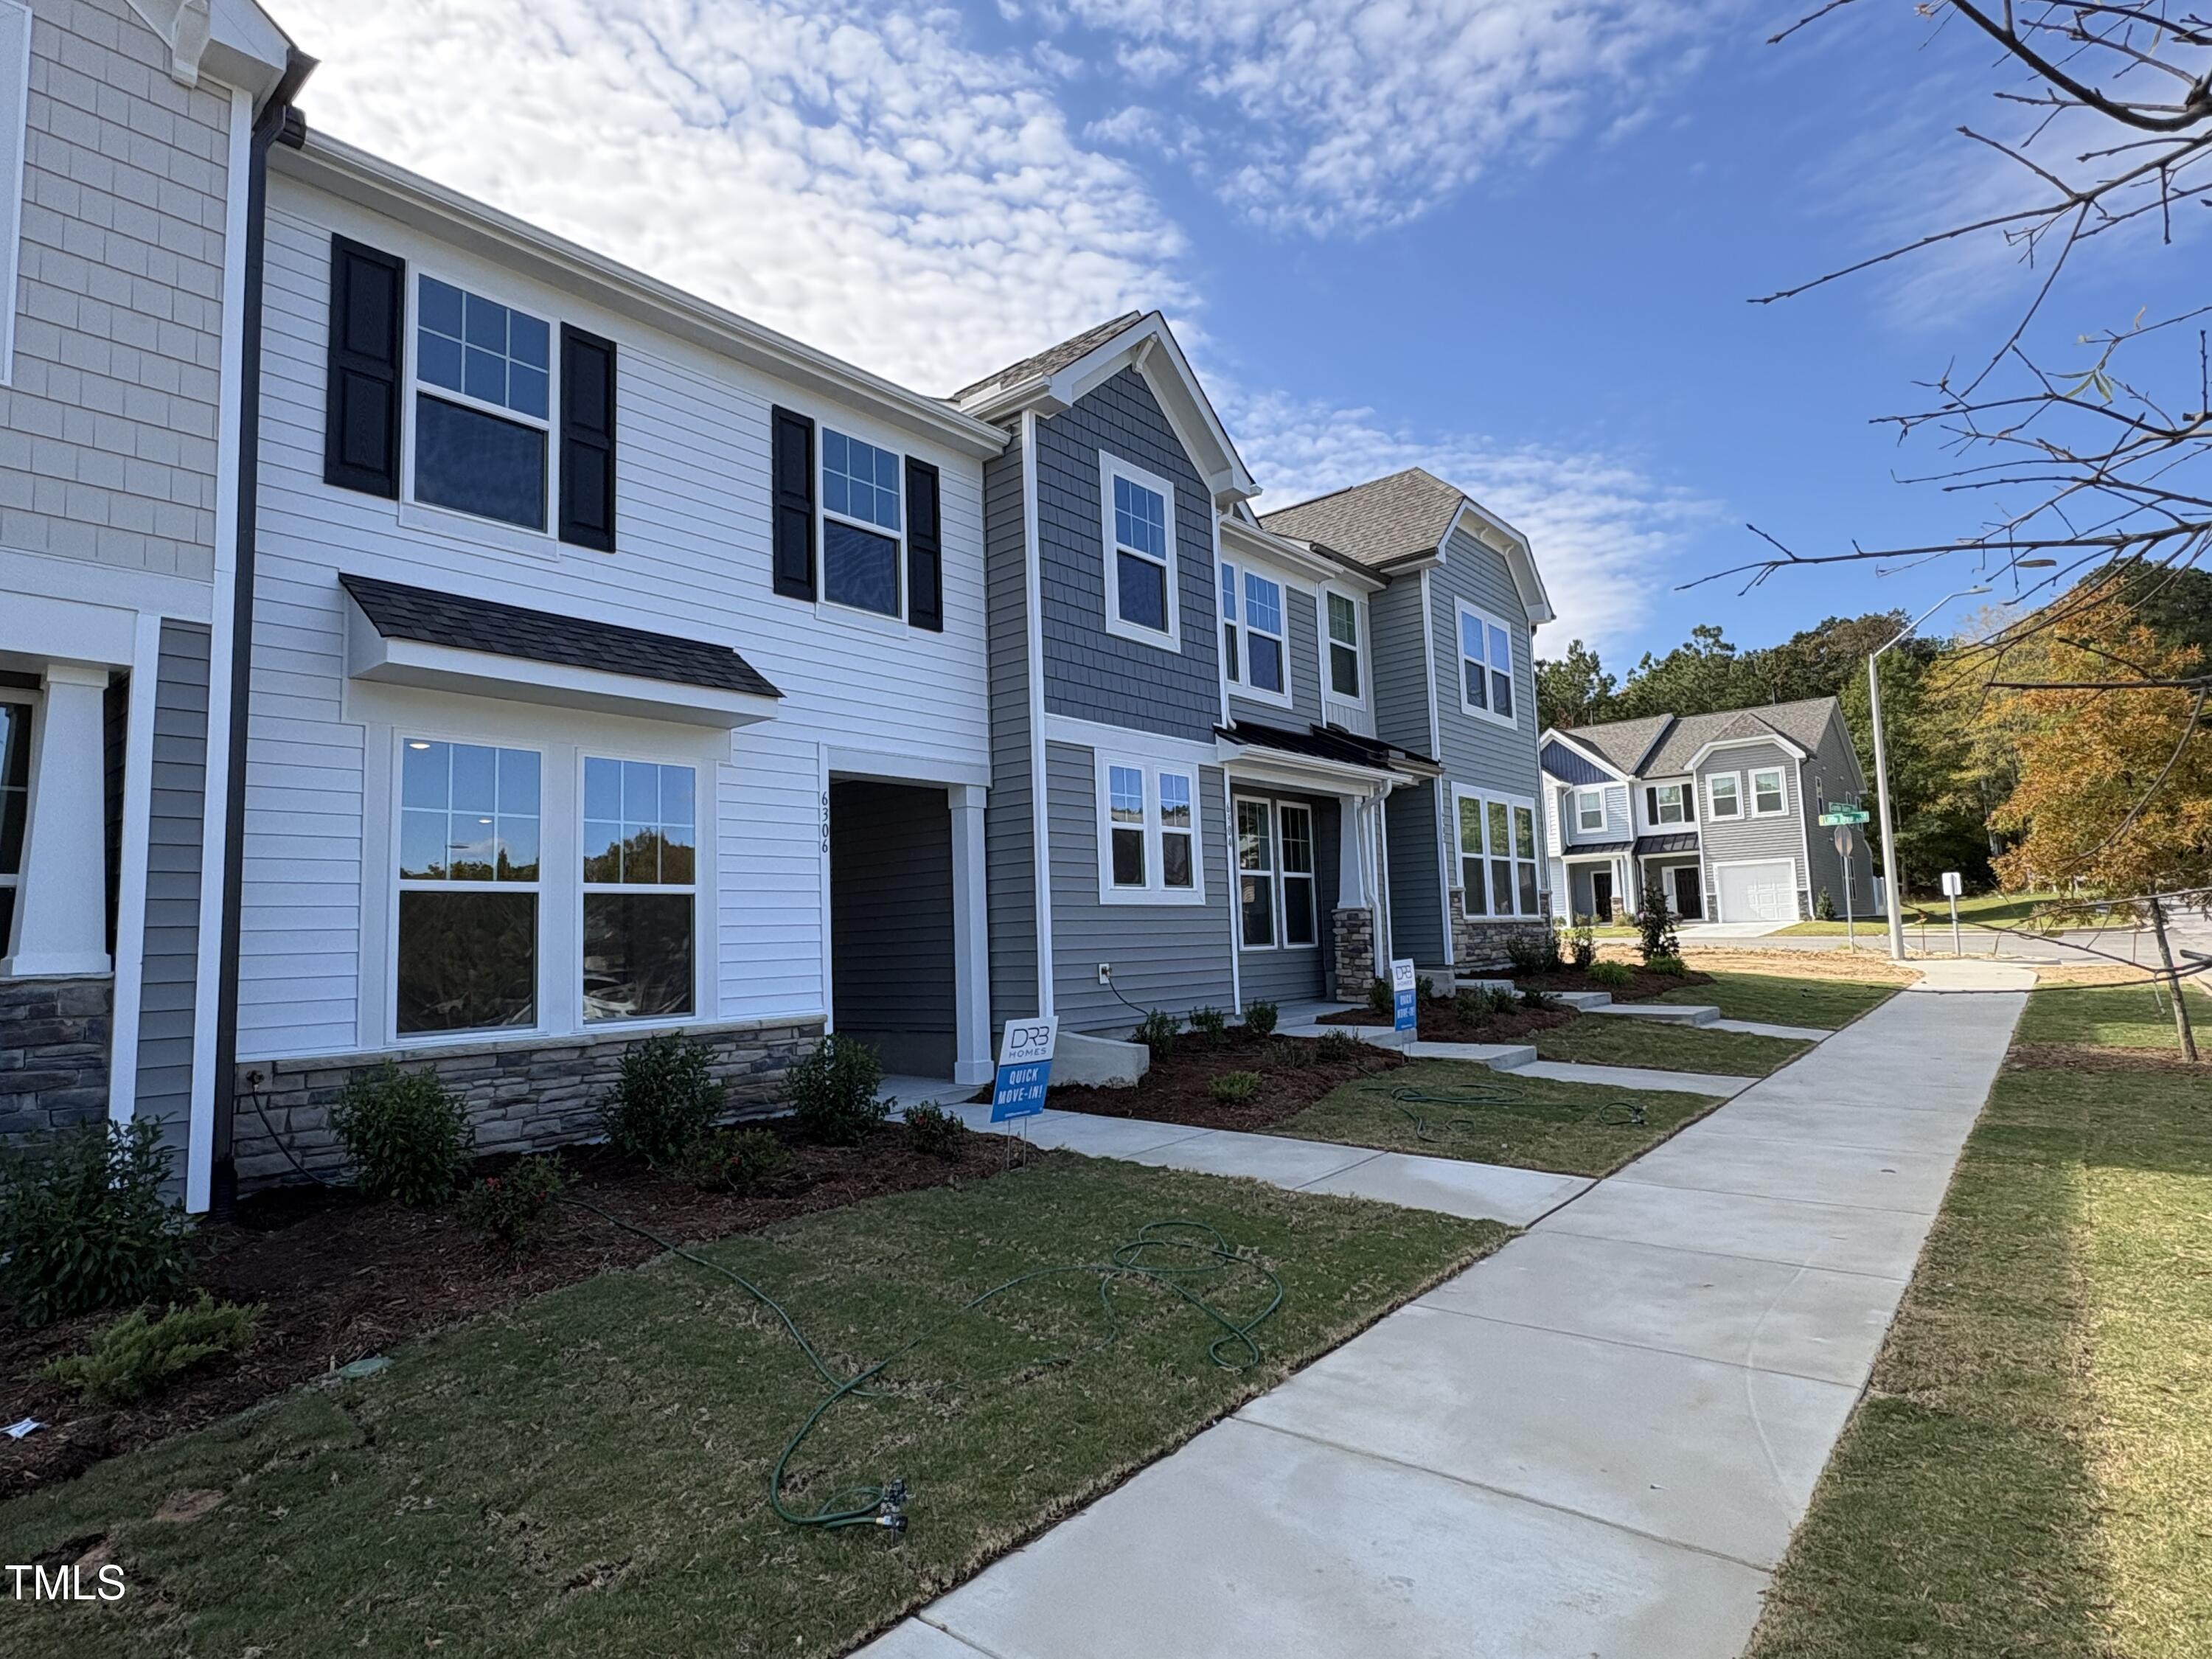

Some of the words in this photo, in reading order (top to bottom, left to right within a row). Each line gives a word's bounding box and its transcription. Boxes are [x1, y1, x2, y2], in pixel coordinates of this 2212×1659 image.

[1011, 1026, 1050, 1049] DRB
[1008, 1047, 1047, 1059] HOMES
[1009, 1068, 1039, 1085] QUICK
[998, 1085, 1043, 1105] MOVE-IN!
